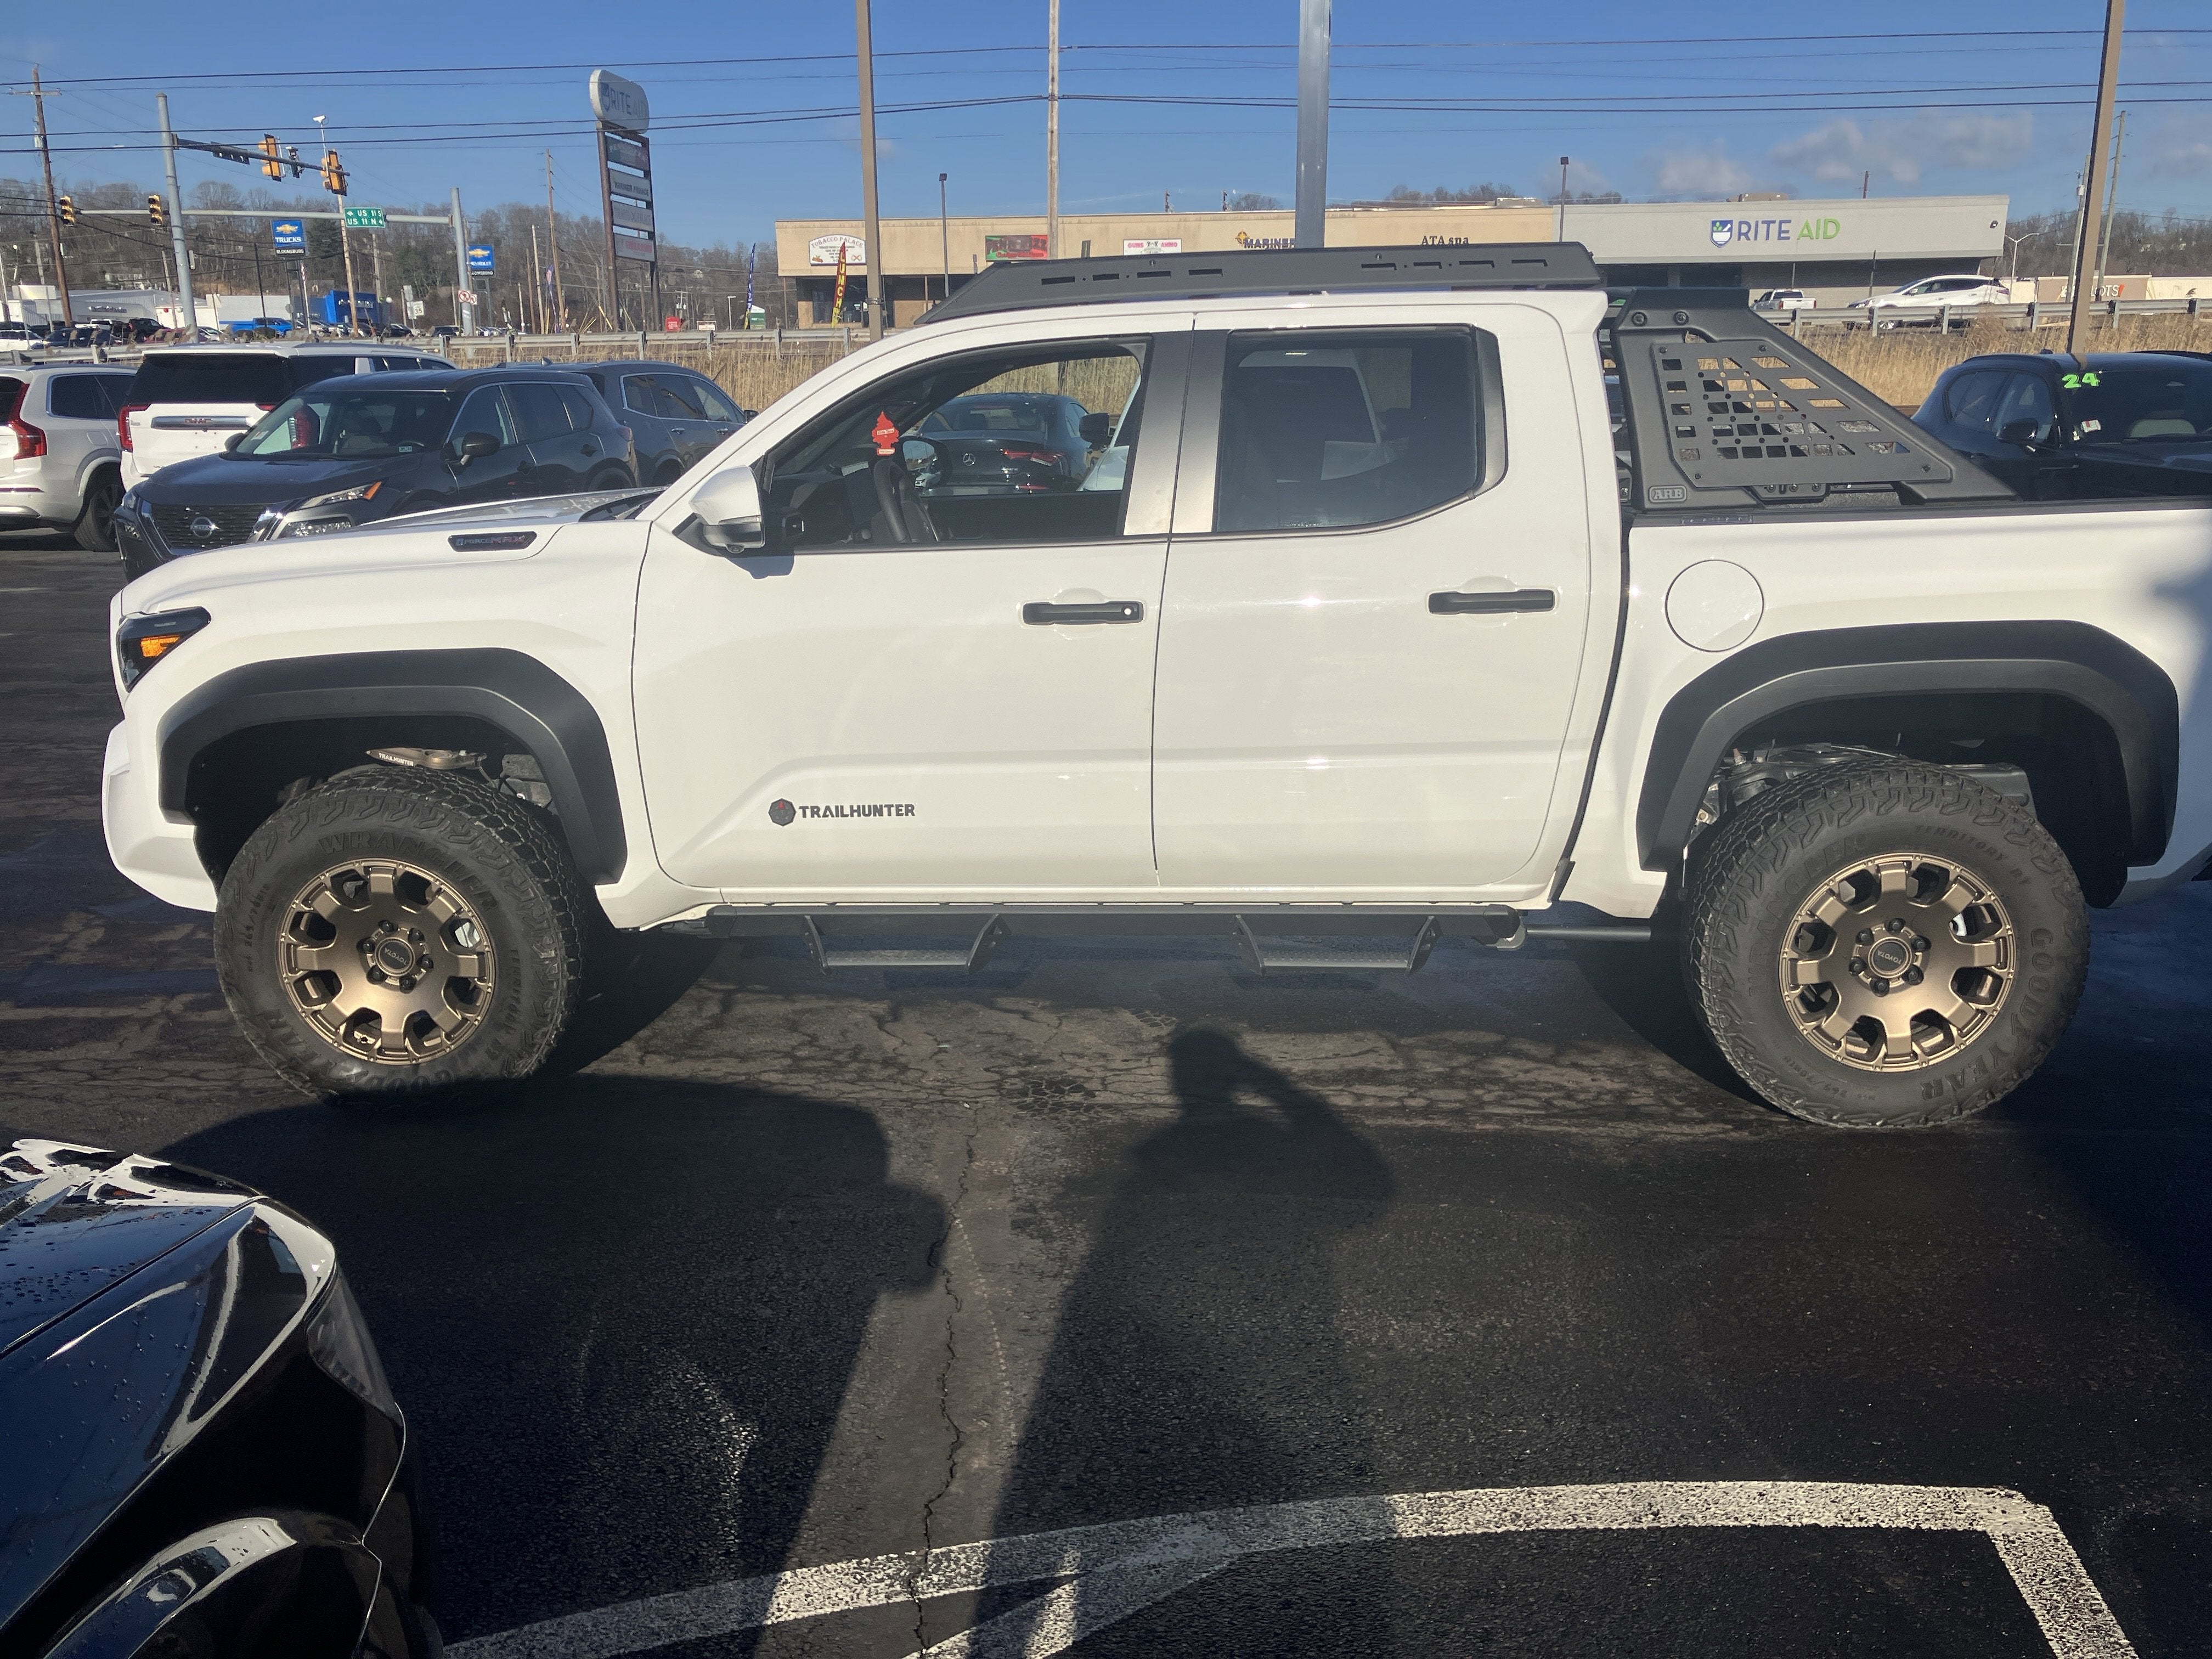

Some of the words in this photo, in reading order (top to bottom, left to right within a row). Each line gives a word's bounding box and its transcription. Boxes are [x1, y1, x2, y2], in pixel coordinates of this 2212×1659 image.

[611, 88, 632, 115] RITE
[1737, 219, 1792, 241] RITE
[1797, 218, 1841, 240] AID
[811, 236, 838, 249] TOBACCO
[839, 236, 864, 248] PALACE
[1244, 238, 1295, 249] MARINER
[1421, 235, 1445, 246] ATA
[1448, 236, 1469, 245] spa
[836, 251, 845, 308] LUNCH
[2062, 373, 2100, 388] 24
[1653, 488, 1684, 500] ARB
[798, 804, 916, 818] TRAILHUNTER
[318, 831, 499, 911] WRANGLER
[385, 947, 408, 966] TOYOTA
[1877, 950, 1902, 964] TOYOTA
[1920, 928, 2055, 1101] GOODYEAR
